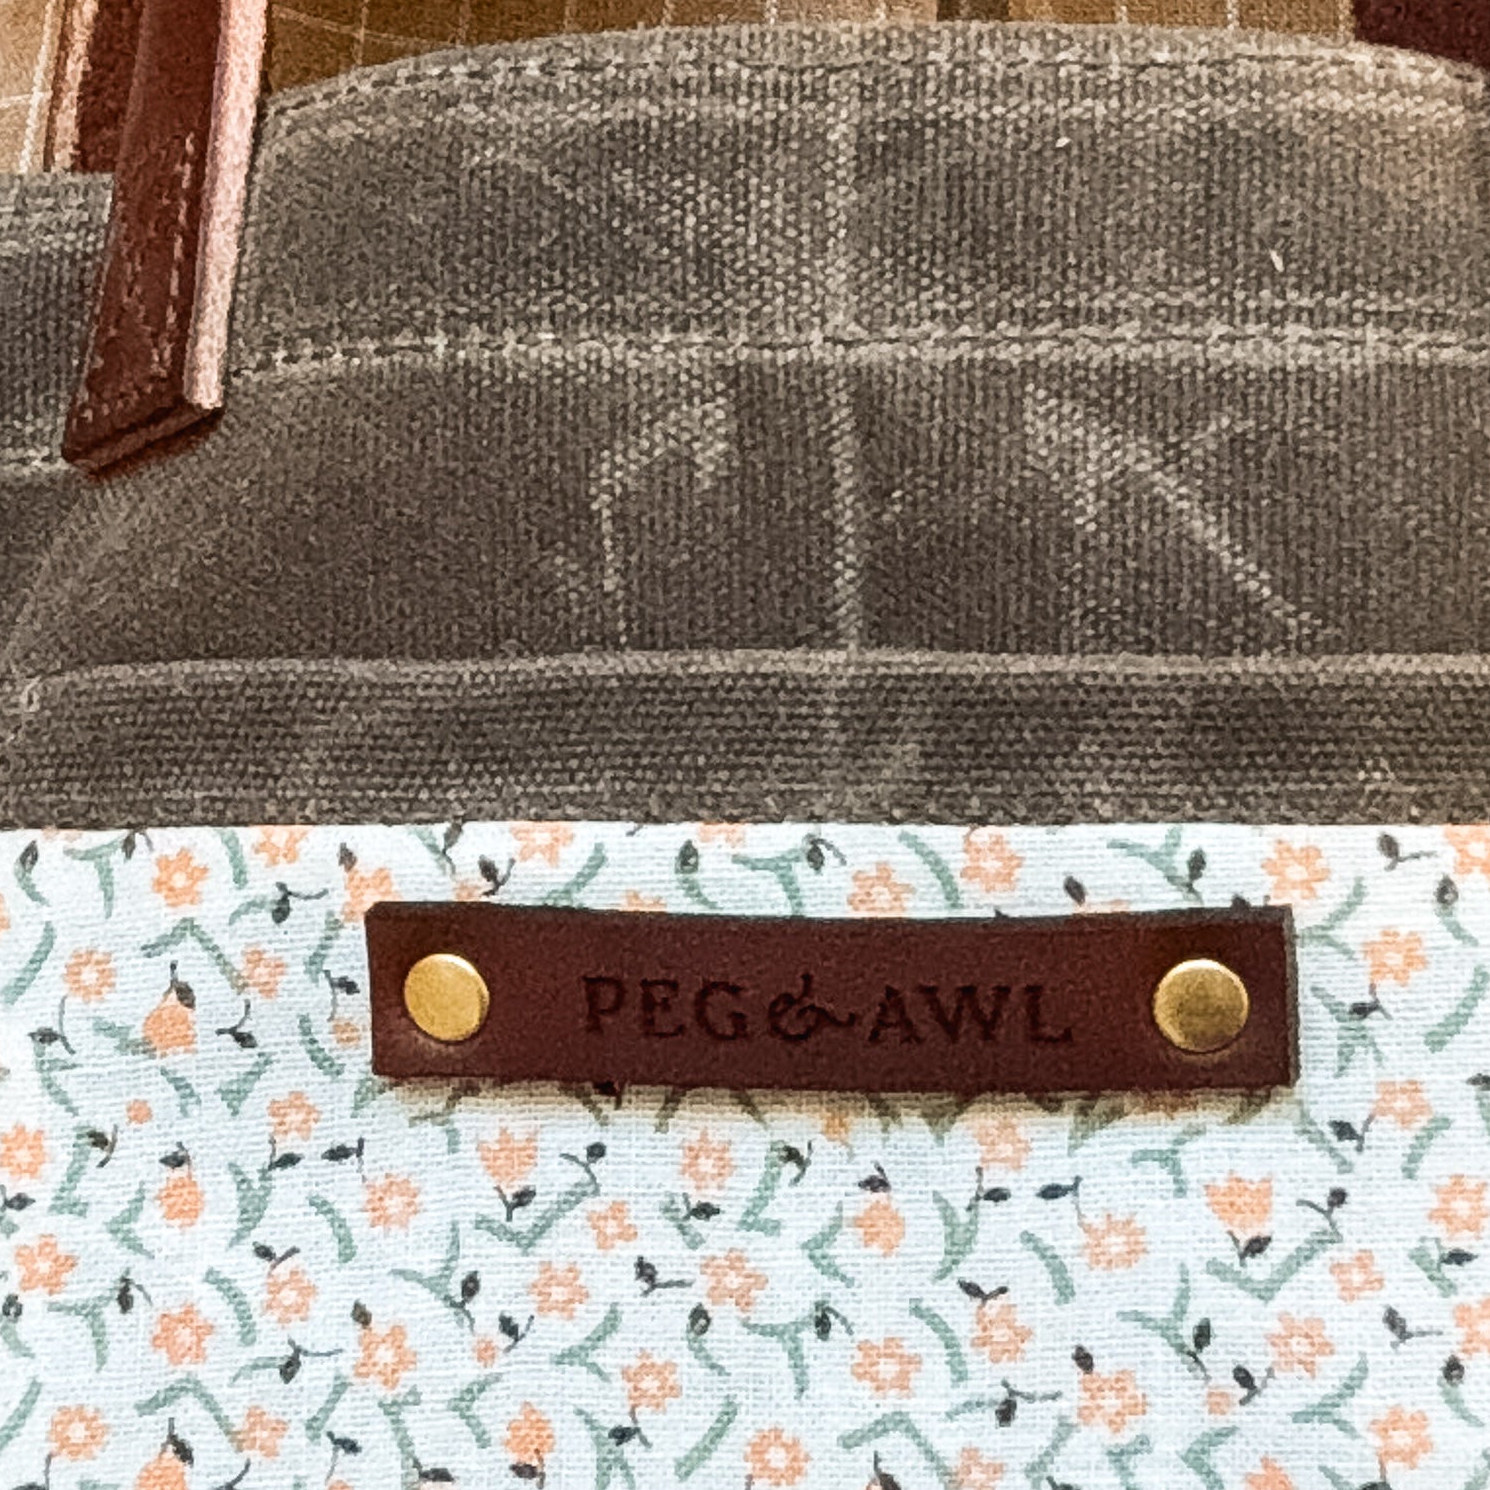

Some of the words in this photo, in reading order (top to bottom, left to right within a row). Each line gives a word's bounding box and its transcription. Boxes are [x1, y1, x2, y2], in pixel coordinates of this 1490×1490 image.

[581, 974, 750, 1042] PEG
[767, 972, 856, 1042] &
[867, 983, 1074, 1044] AWL
